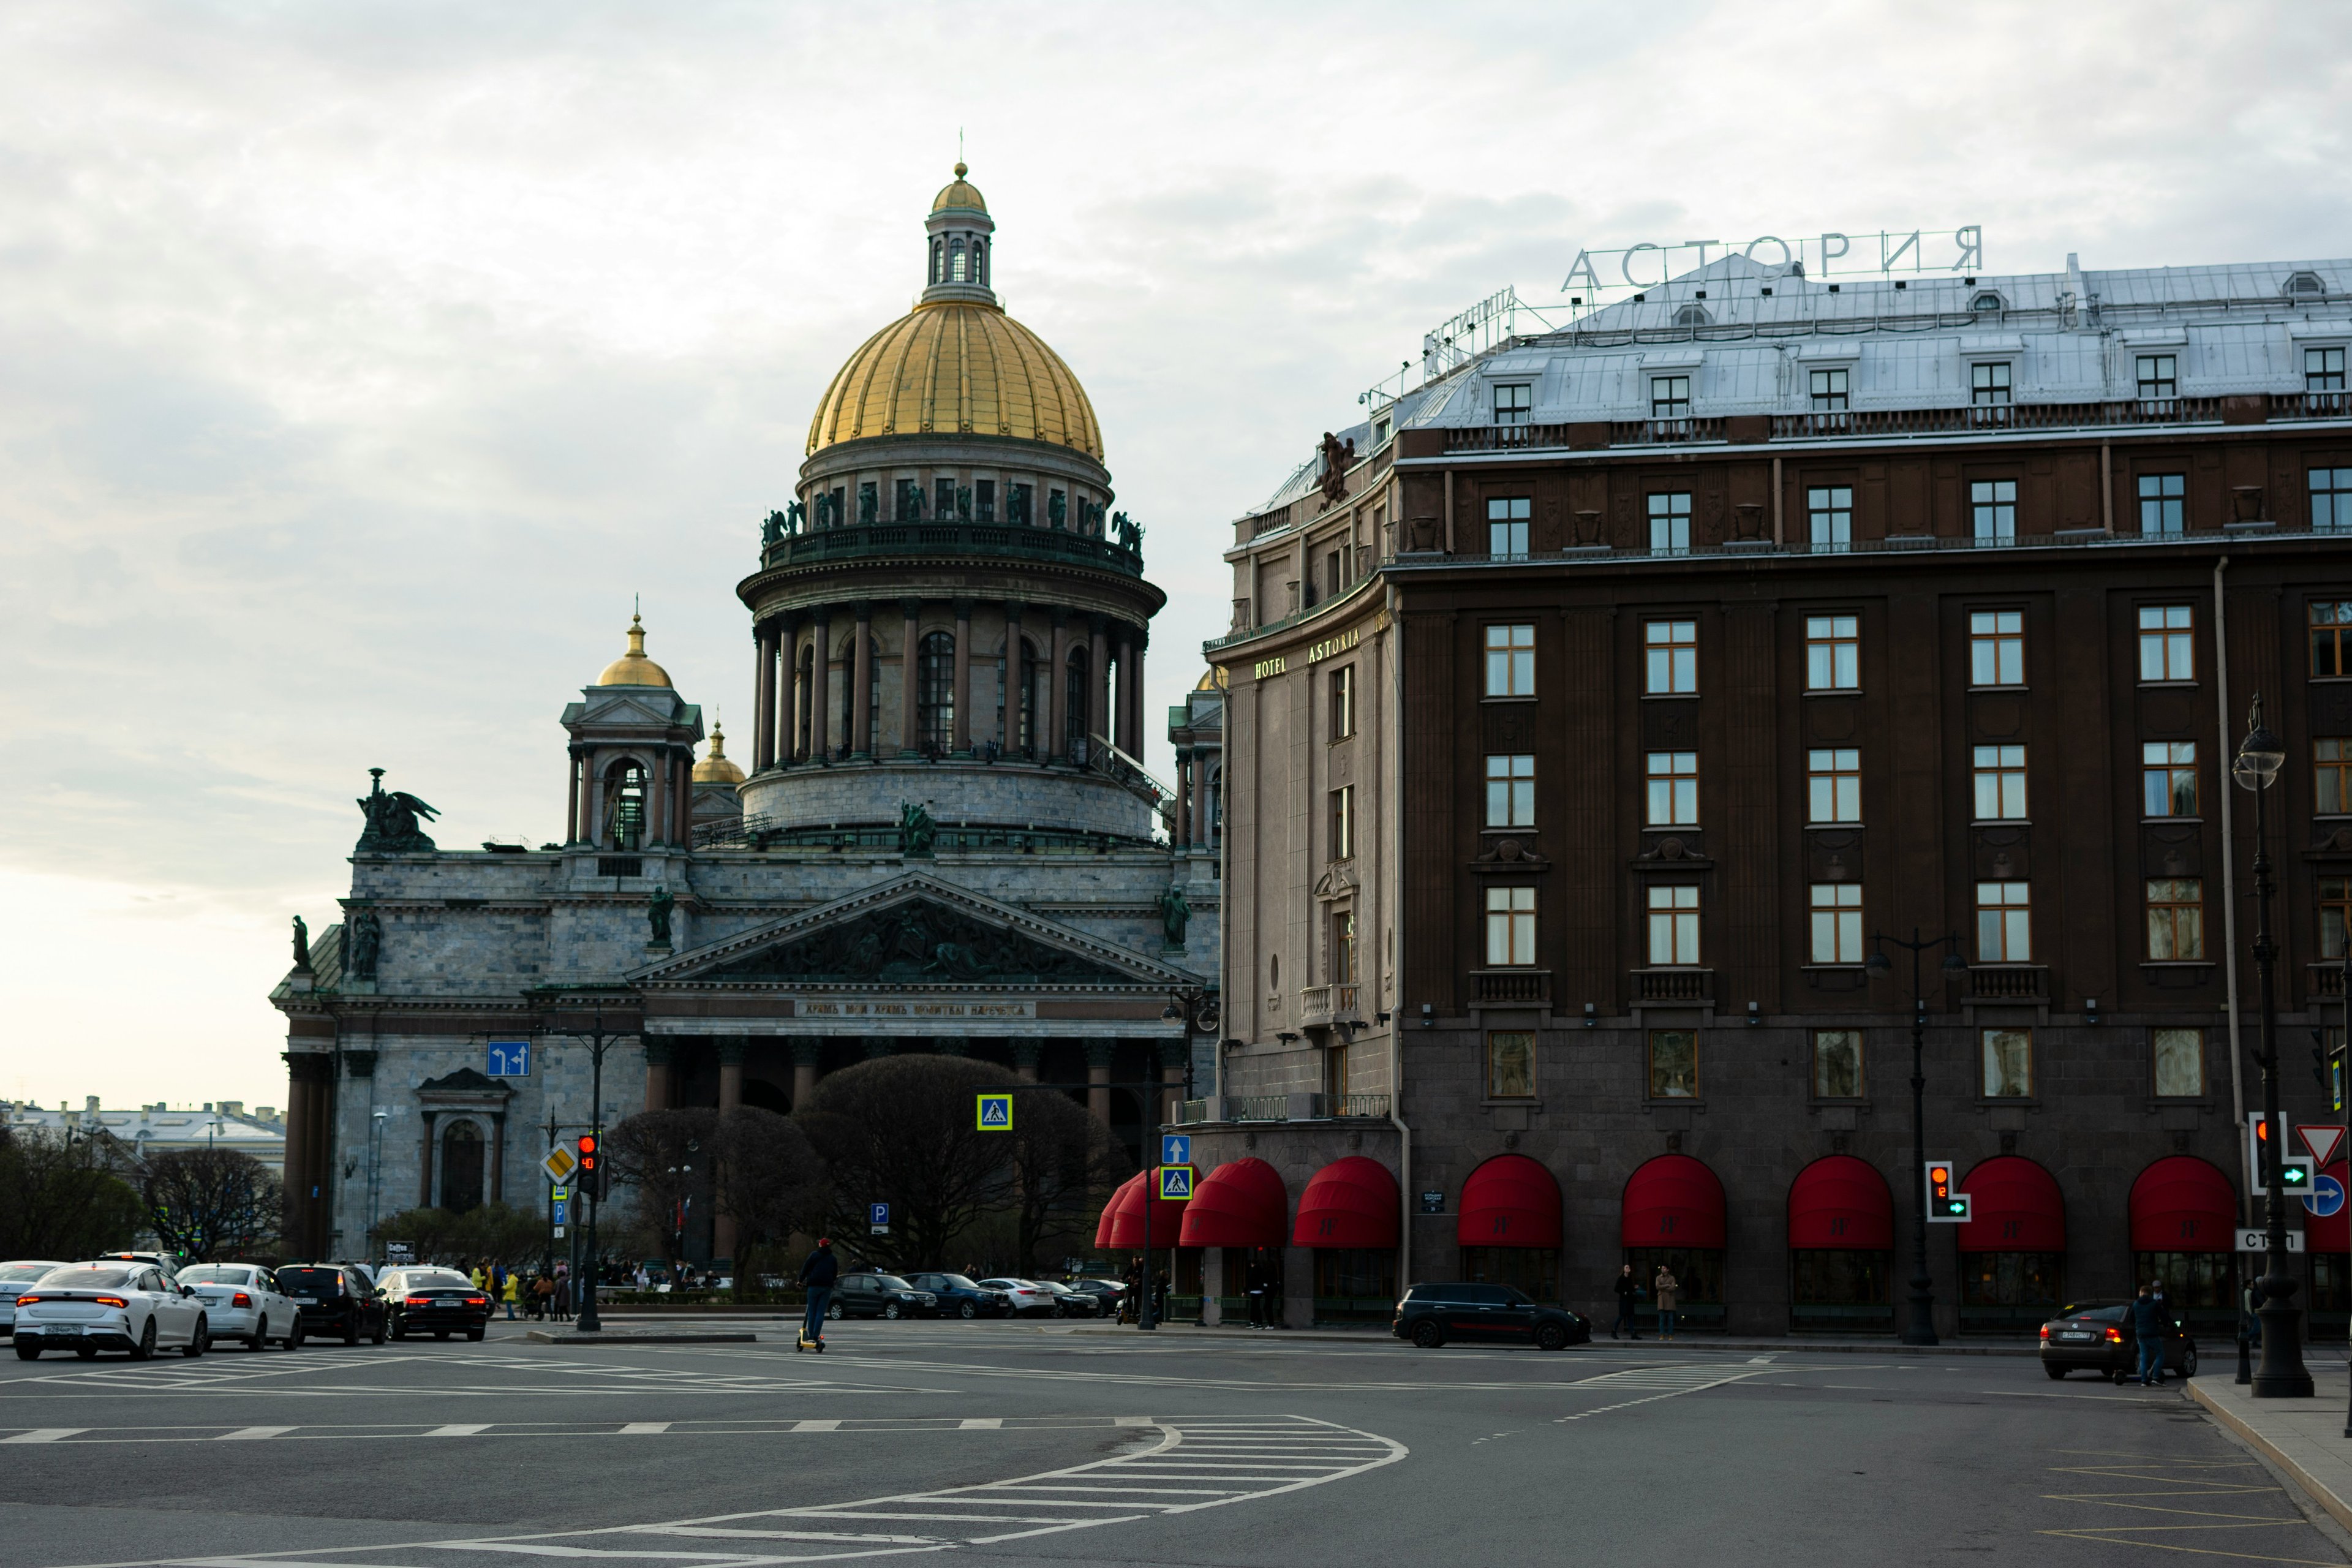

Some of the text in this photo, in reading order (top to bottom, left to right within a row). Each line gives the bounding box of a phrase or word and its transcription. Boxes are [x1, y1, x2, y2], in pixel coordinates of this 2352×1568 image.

[1561, 225, 1982, 292] АСТОРИЯ
[1255, 628, 1359, 679] HOTEL ASTORIA
[582, 1158, 593, 1169] 40
[876, 1205, 886, 1222] P
[2245, 1233, 2294, 1248] СТП
